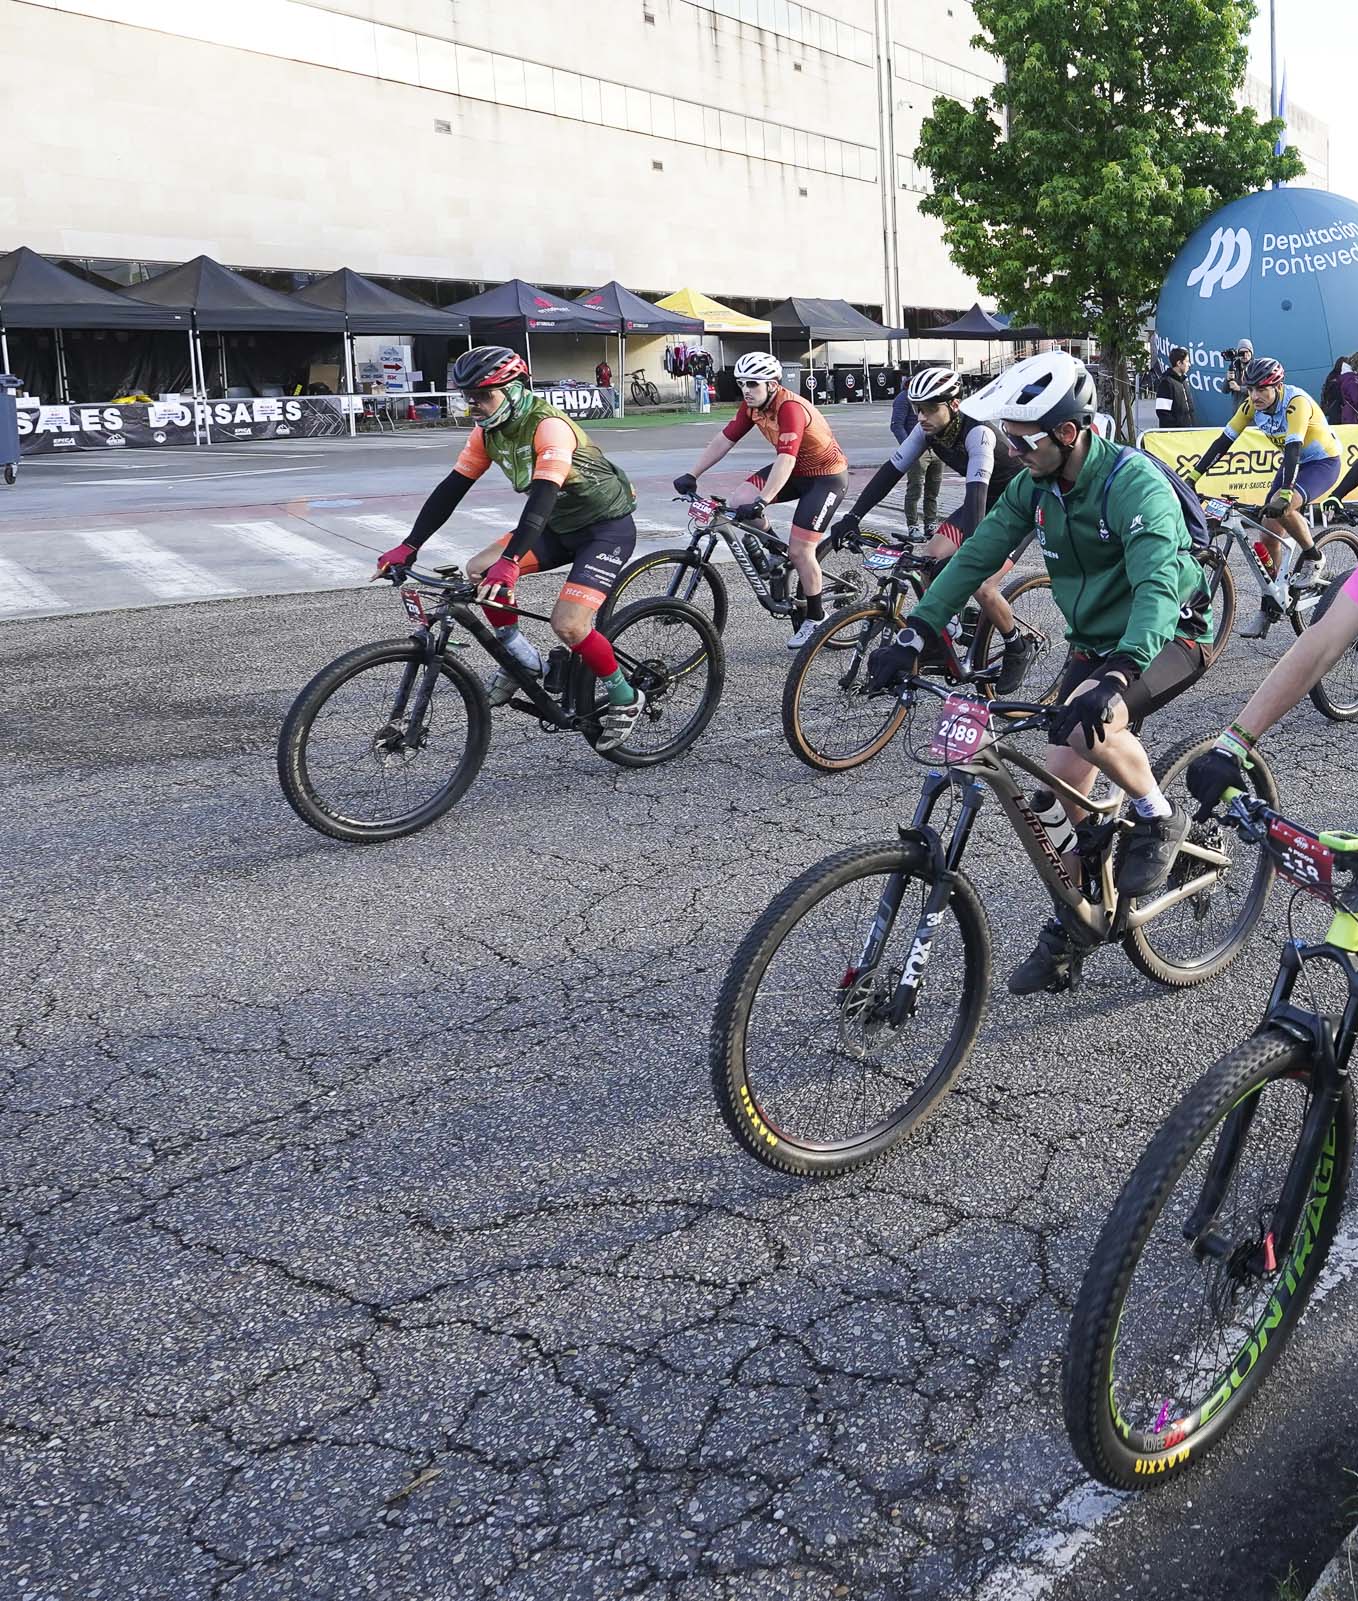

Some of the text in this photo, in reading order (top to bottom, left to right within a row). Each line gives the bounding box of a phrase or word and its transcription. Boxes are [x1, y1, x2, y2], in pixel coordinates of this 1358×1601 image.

[729, 540, 767, 597] SPECIALIZED
[1012, 795, 1074, 890] LAPIERRE
[900, 938, 932, 989] FOX
[740, 1086, 778, 1148] MAXXIS
[1199, 1112, 1336, 1425] BONTRAGE
[1134, 1447, 1191, 1475] MAXXIS
